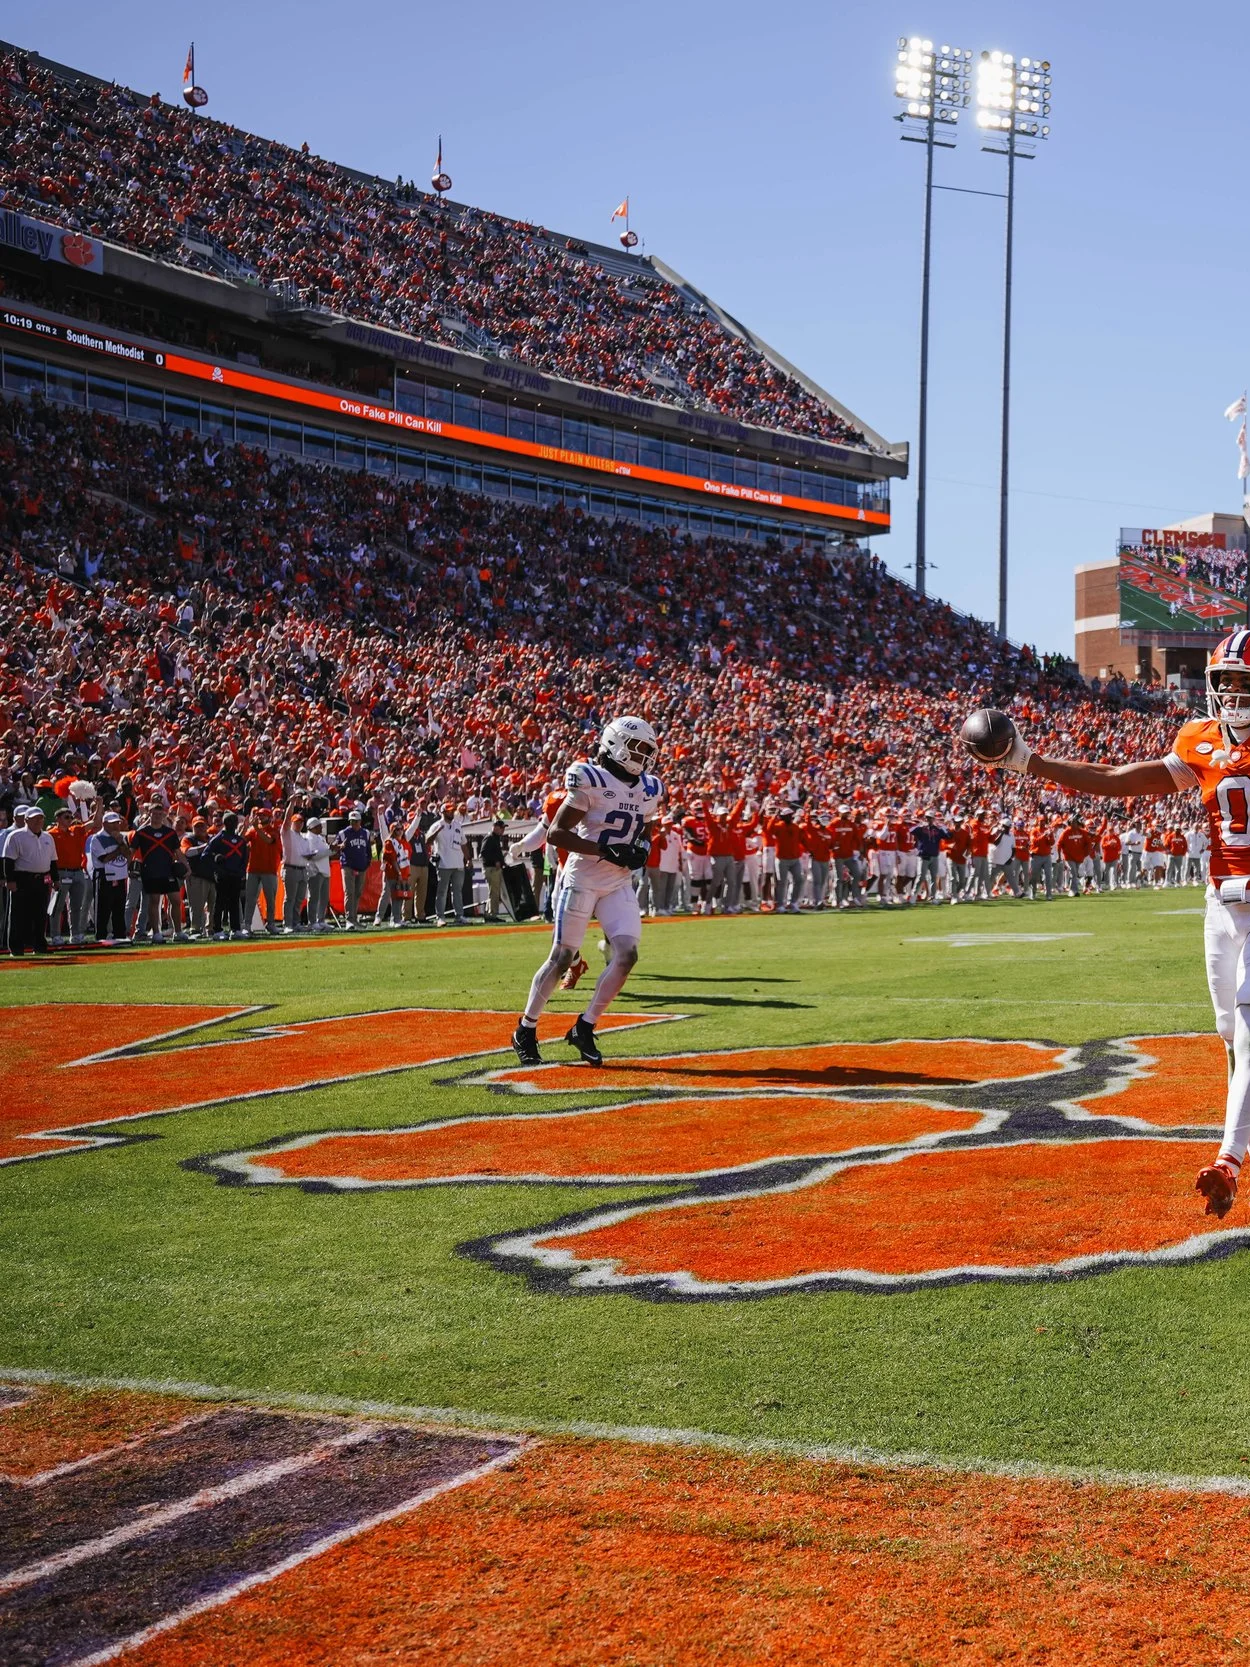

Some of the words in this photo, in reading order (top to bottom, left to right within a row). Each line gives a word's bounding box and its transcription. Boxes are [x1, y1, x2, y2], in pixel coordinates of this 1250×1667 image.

[4, 313, 32, 329] 10:19
[36, 323, 51, 334] QTR
[66, 329, 104, 350] Southern
[105, 339, 144, 361] Methodist
[155, 354, 164, 365] 0
[340, 399, 361, 414] One
[362, 405, 386, 420] Fake
[387, 411, 403, 424] Pill
[405, 415, 424, 430] Can
[426, 420, 442, 433] Kill
[538, 445, 558, 460] JUST
[560, 450, 584, 466] PLAIN
[703, 481, 719, 493] One
[721, 484, 740, 498] Fake
[740, 487, 753, 499] Pill
[753, 490, 769, 502] Can
[769, 493, 782, 505] Kill
[619, 803, 640, 812] DUKE
[598, 810, 645, 846] 21
[887, 831, 897, 843] 17
[350, 838, 367, 847] TIGERS
